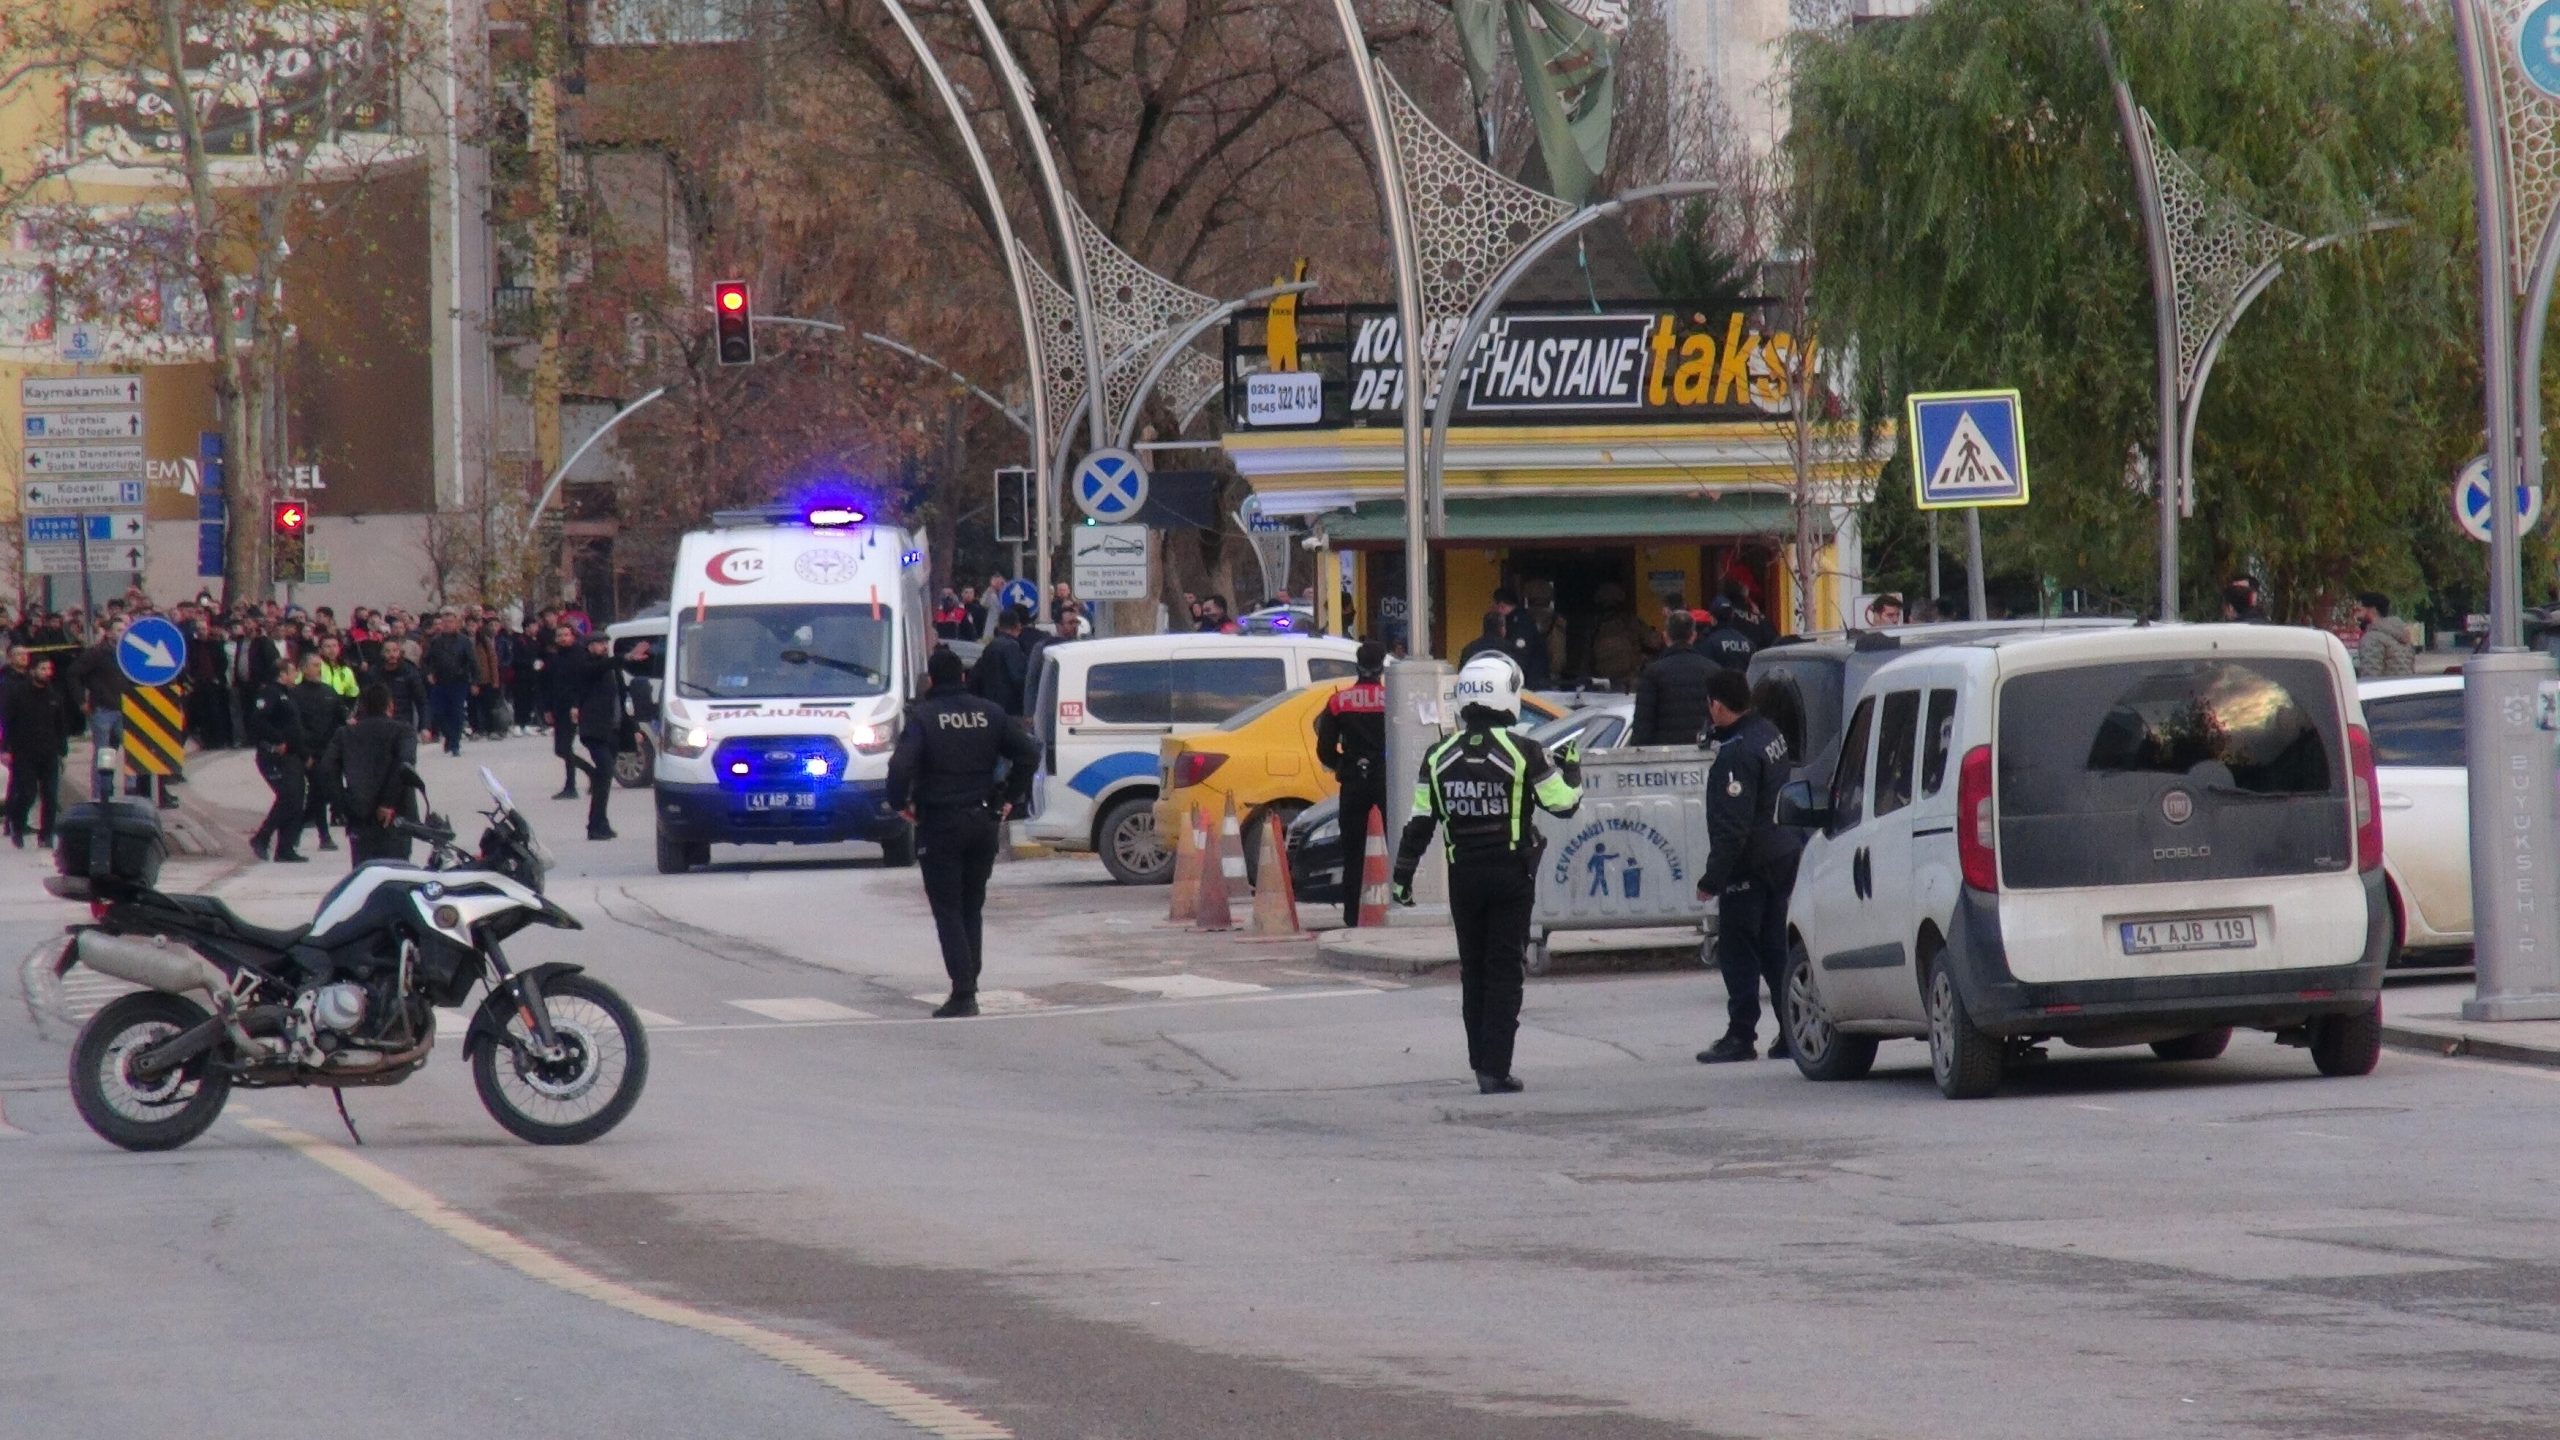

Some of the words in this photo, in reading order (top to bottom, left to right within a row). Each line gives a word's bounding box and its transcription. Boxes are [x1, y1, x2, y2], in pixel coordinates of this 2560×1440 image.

[1485, 338, 1640, 397] HASTANE
[25, 386, 120, 400] Kaymakamlık
[58, 484, 104, 493] Kocaeli
[31, 517, 95, 529] İstanbl
[730, 559, 764, 571] 112
[1062, 703, 1081, 716] 112
[2153, 846, 2211, 860] DOBLO
[2137, 926, 2156, 945] 41
[2169, 922, 2204, 944] AJB
[2214, 919, 2246, 940] 119
